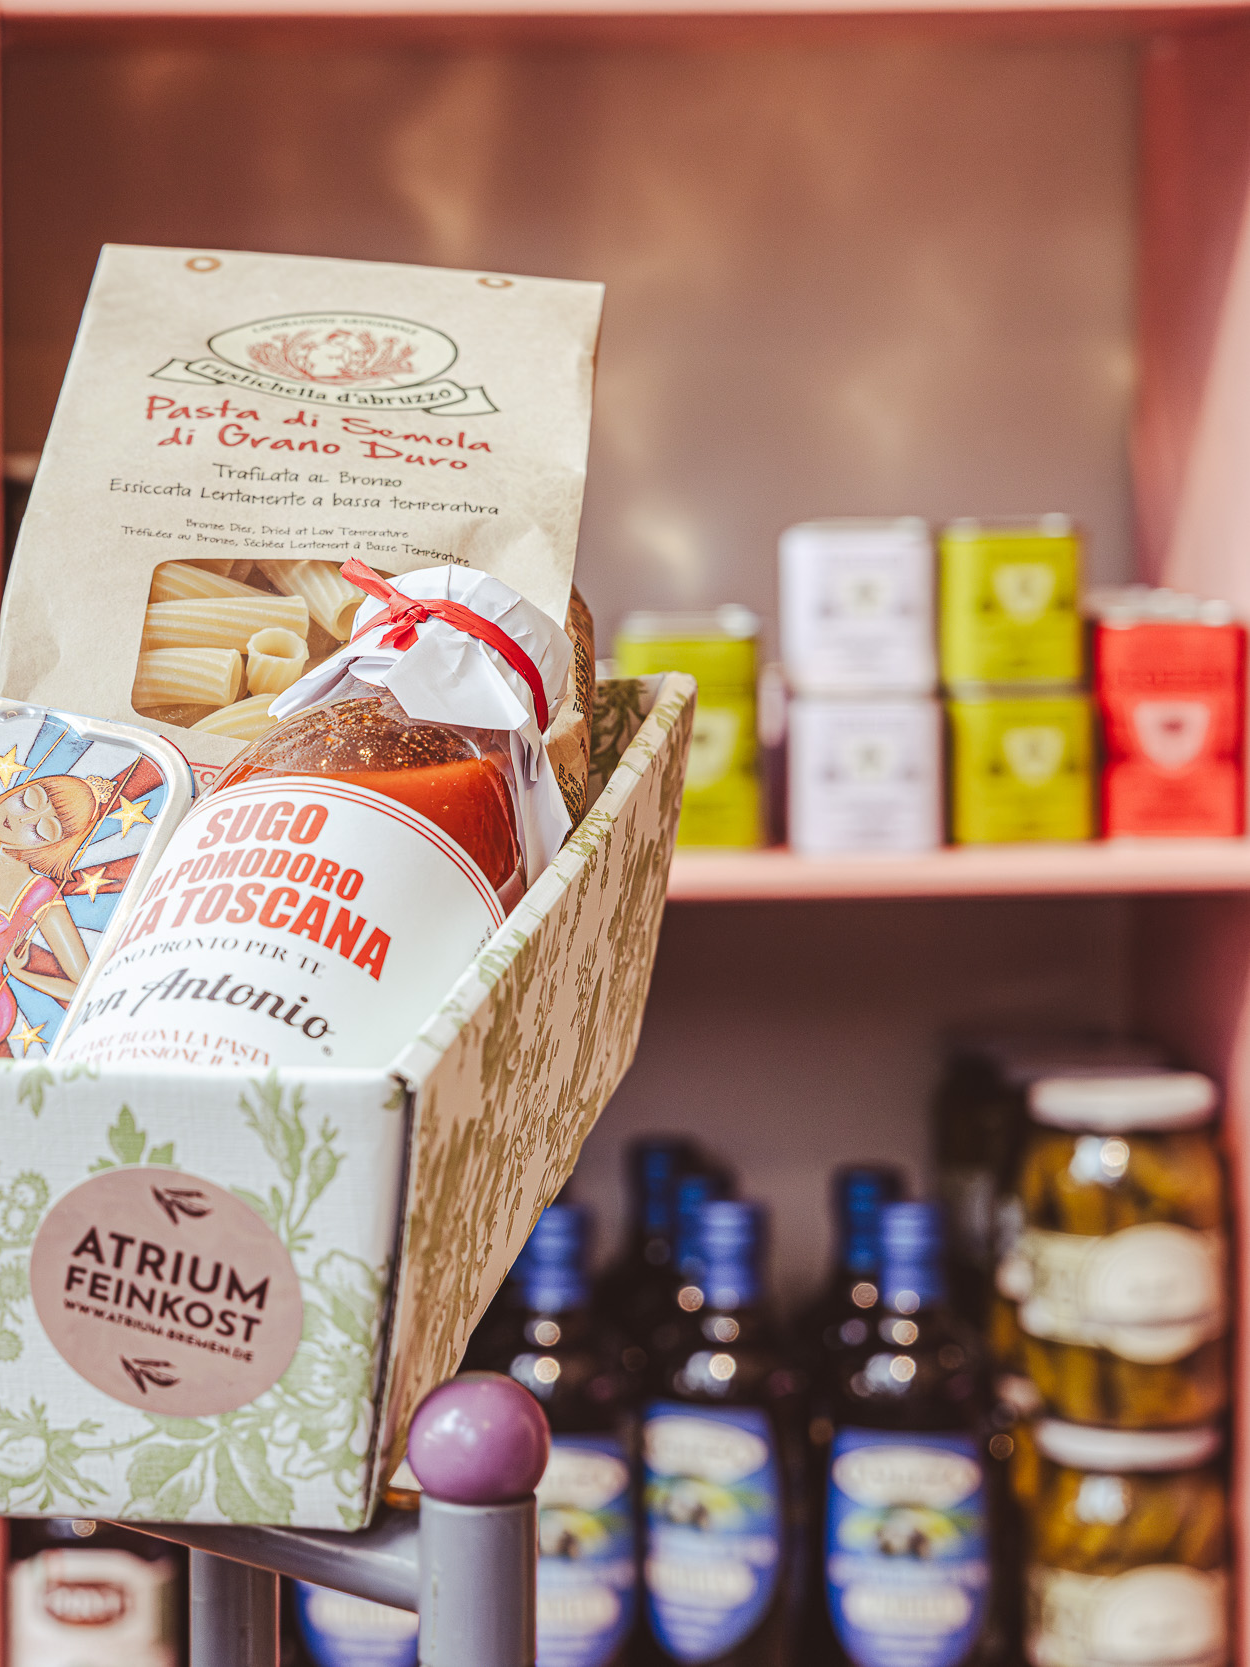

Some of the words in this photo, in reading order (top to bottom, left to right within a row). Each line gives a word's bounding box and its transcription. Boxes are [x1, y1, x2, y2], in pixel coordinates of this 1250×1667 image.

[146, 395, 261, 422] Pasta
[284, 410, 320, 428] di
[341, 416, 493, 454] Semola
[158, 427, 195, 447] di
[217, 423, 341, 454] Grano
[359, 440, 469, 470] Duro
[110, 478, 192, 498] Essiccata
[200, 487, 307, 506] Lentamente
[312, 496, 324, 507] a
[332, 493, 381, 508] bassa
[339, 471, 403, 488] Bronzo
[177, 532, 191, 541] au
[366, 541, 398, 553] Basse
[186, 518, 225, 531] Bronze
[261, 525, 291, 536] Dried
[297, 527, 308, 536] at
[312, 527, 334, 537] Low
[197, 800, 330, 850] SUGO
[169, 847, 364, 902] POMODORO
[150, 936, 238, 958] PRONTO
[244, 939, 288, 962] PER
[170, 882, 392, 983] TOSCANA
[130, 967, 336, 1041] Antonio
[71, 1225, 271, 1311] ATRIUM
[64, 1264, 263, 1343] FEINKOST
